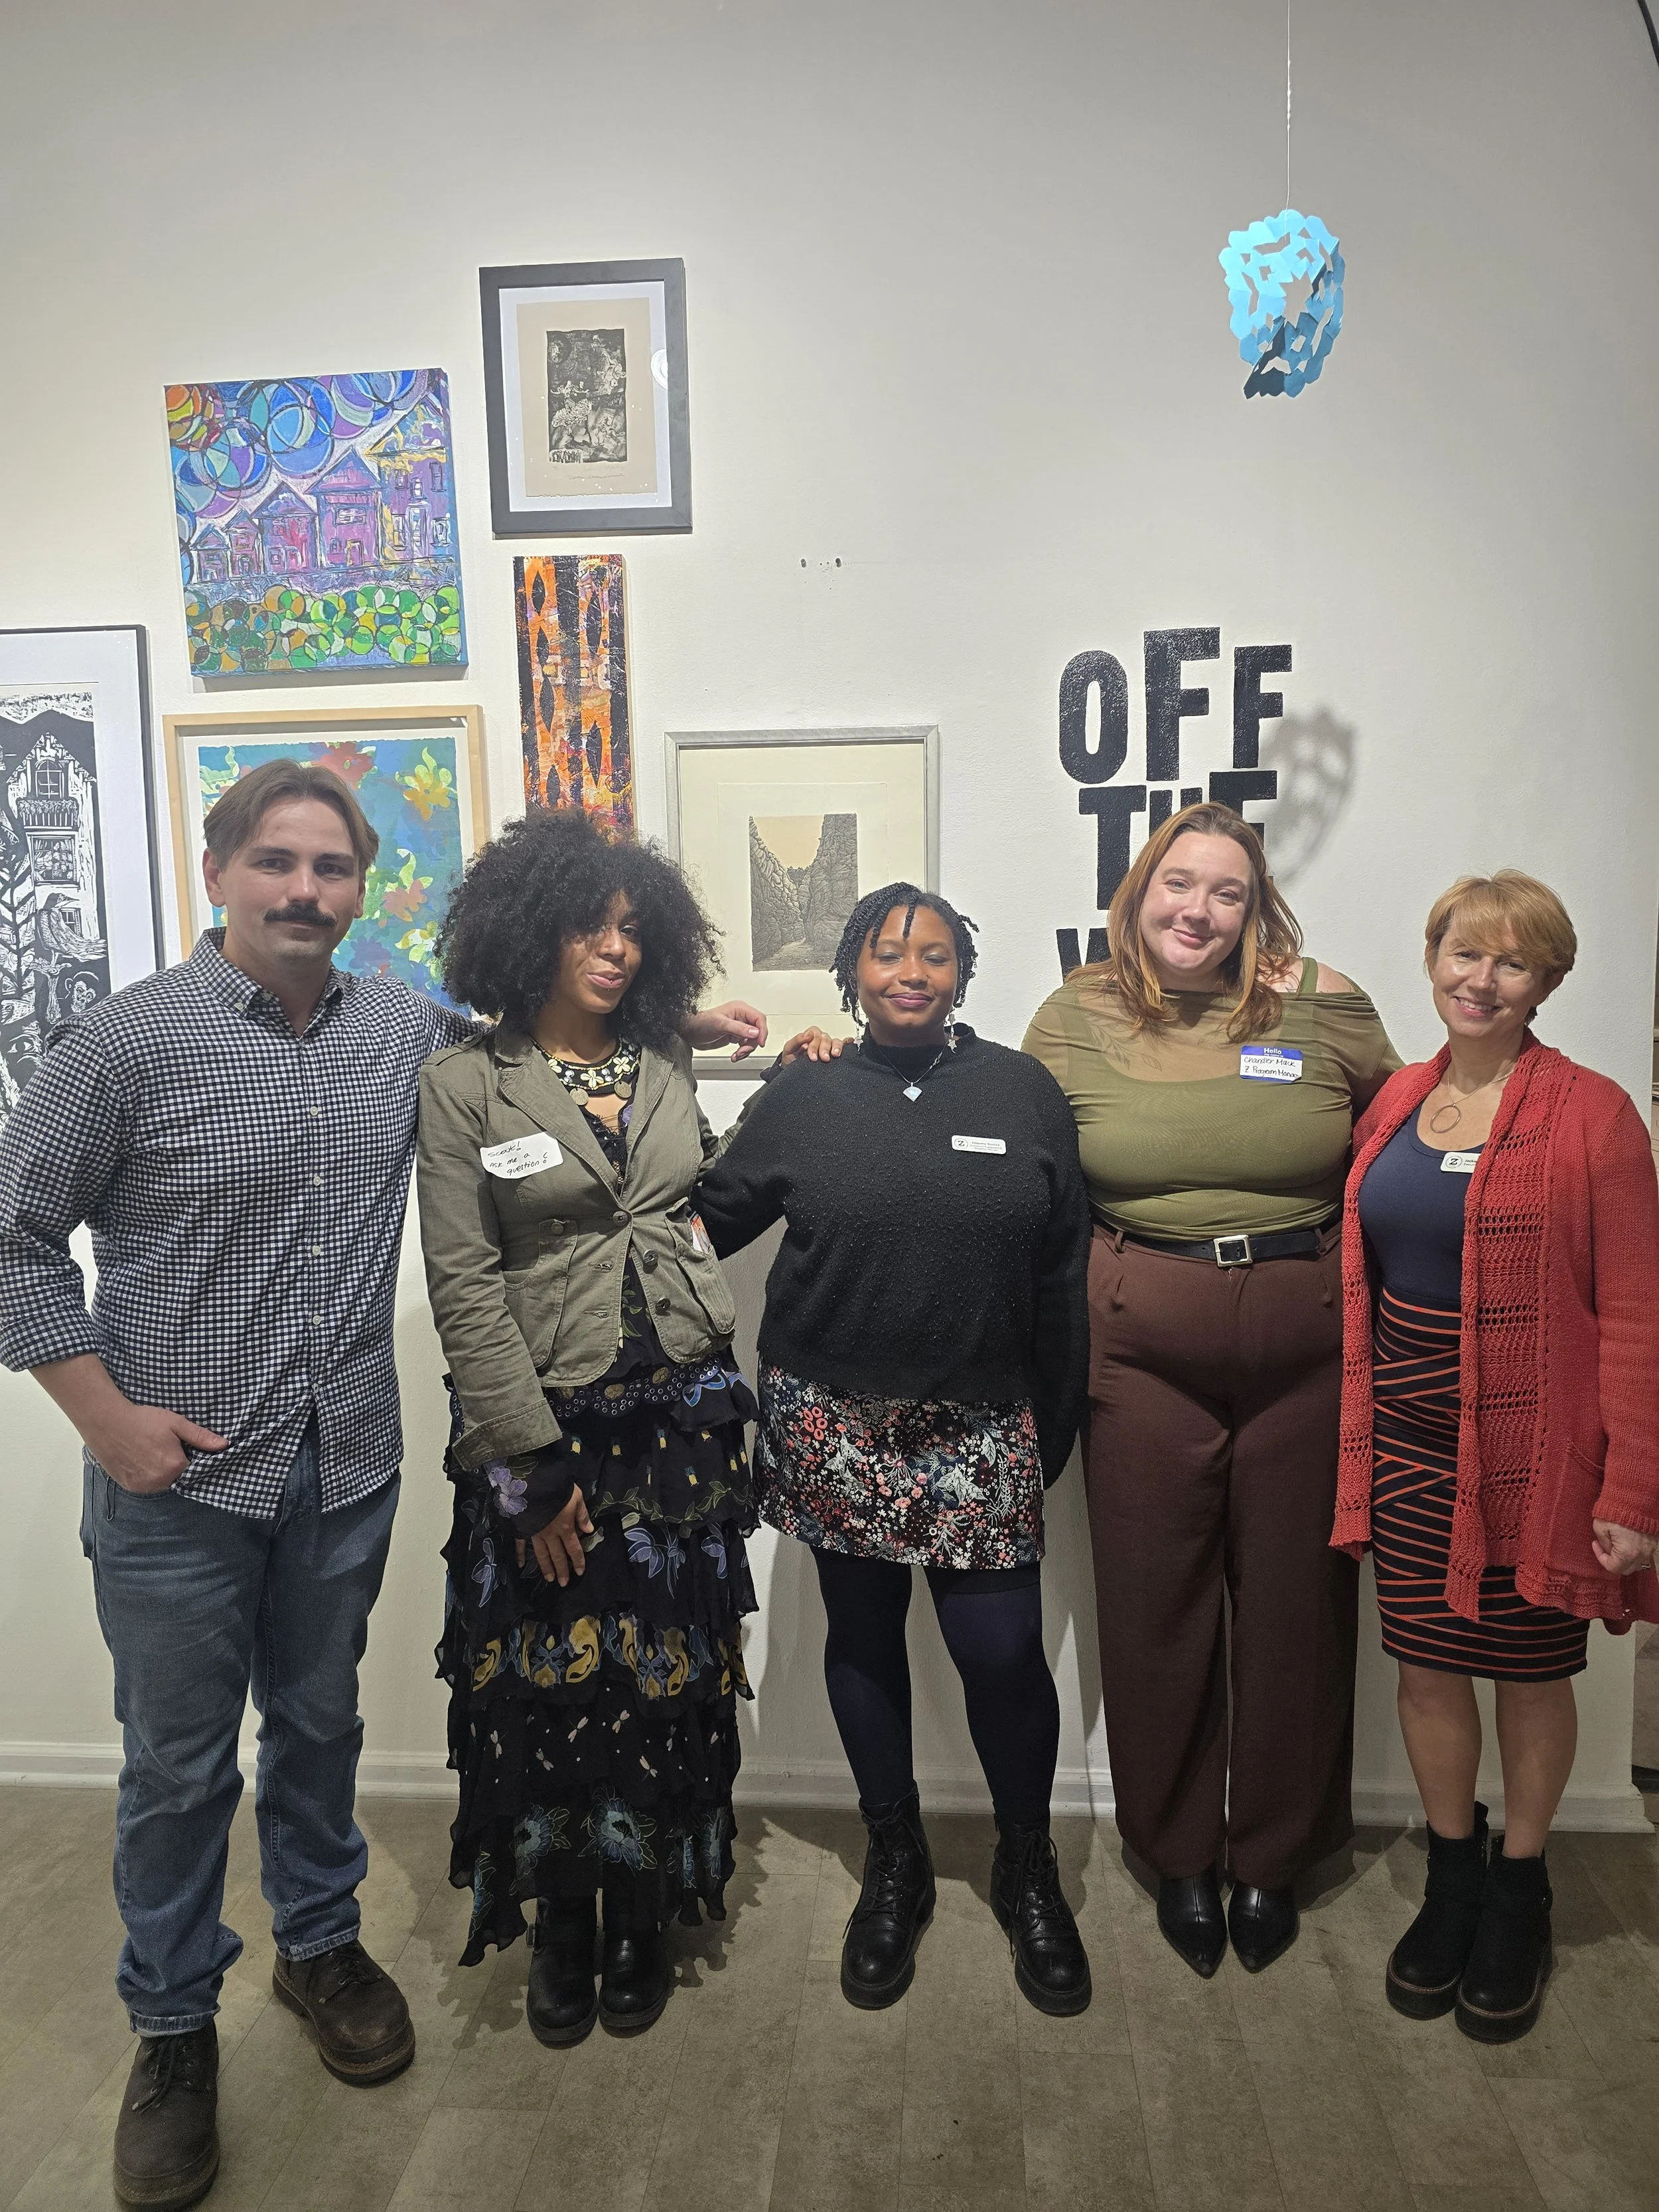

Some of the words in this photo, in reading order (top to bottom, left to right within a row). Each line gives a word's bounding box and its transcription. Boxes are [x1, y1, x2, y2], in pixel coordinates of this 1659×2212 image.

[1059, 627, 1292, 784] OFF
[1079, 771, 1277, 910] TE
[1244, 1056, 1275, 1065] Chandler
[1252, 1065, 1277, 1078] Program
